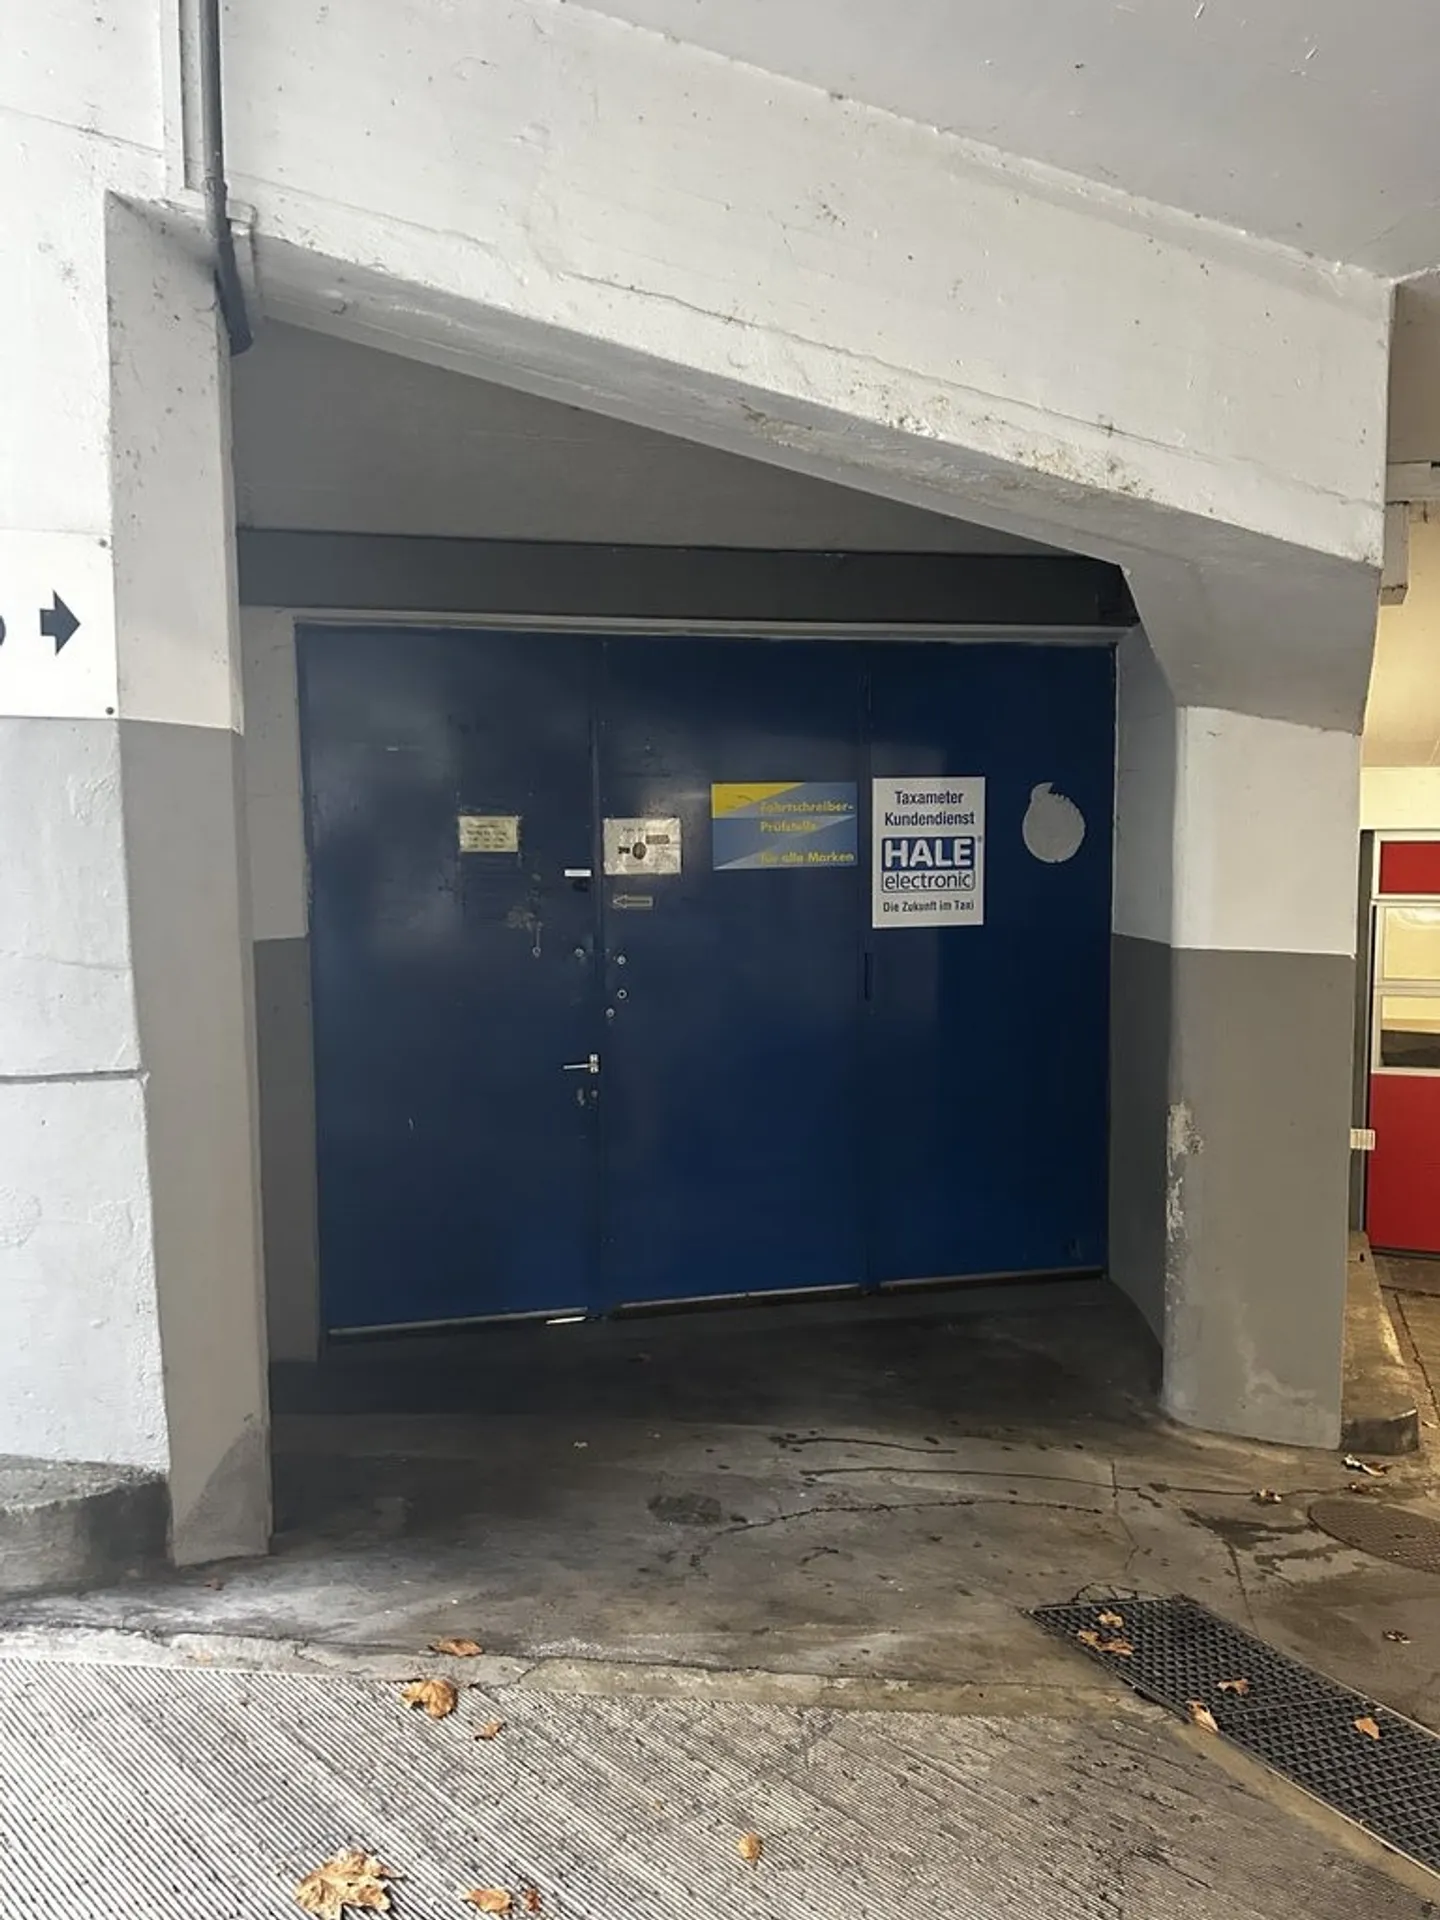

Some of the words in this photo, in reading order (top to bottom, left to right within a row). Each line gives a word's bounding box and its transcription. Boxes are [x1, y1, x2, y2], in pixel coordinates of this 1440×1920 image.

[894, 791, 964, 805] Taxameter
[885, 811, 975, 827] Kundendienst
[807, 851, 854, 863] Marken
[885, 839, 972, 868] HALE
[885, 872, 971, 890] electronic
[883, 901, 899, 912] Die
[902, 901, 936, 912] Zukunft
[940, 900, 952, 911] im
[955, 900, 975, 911] Taxi
